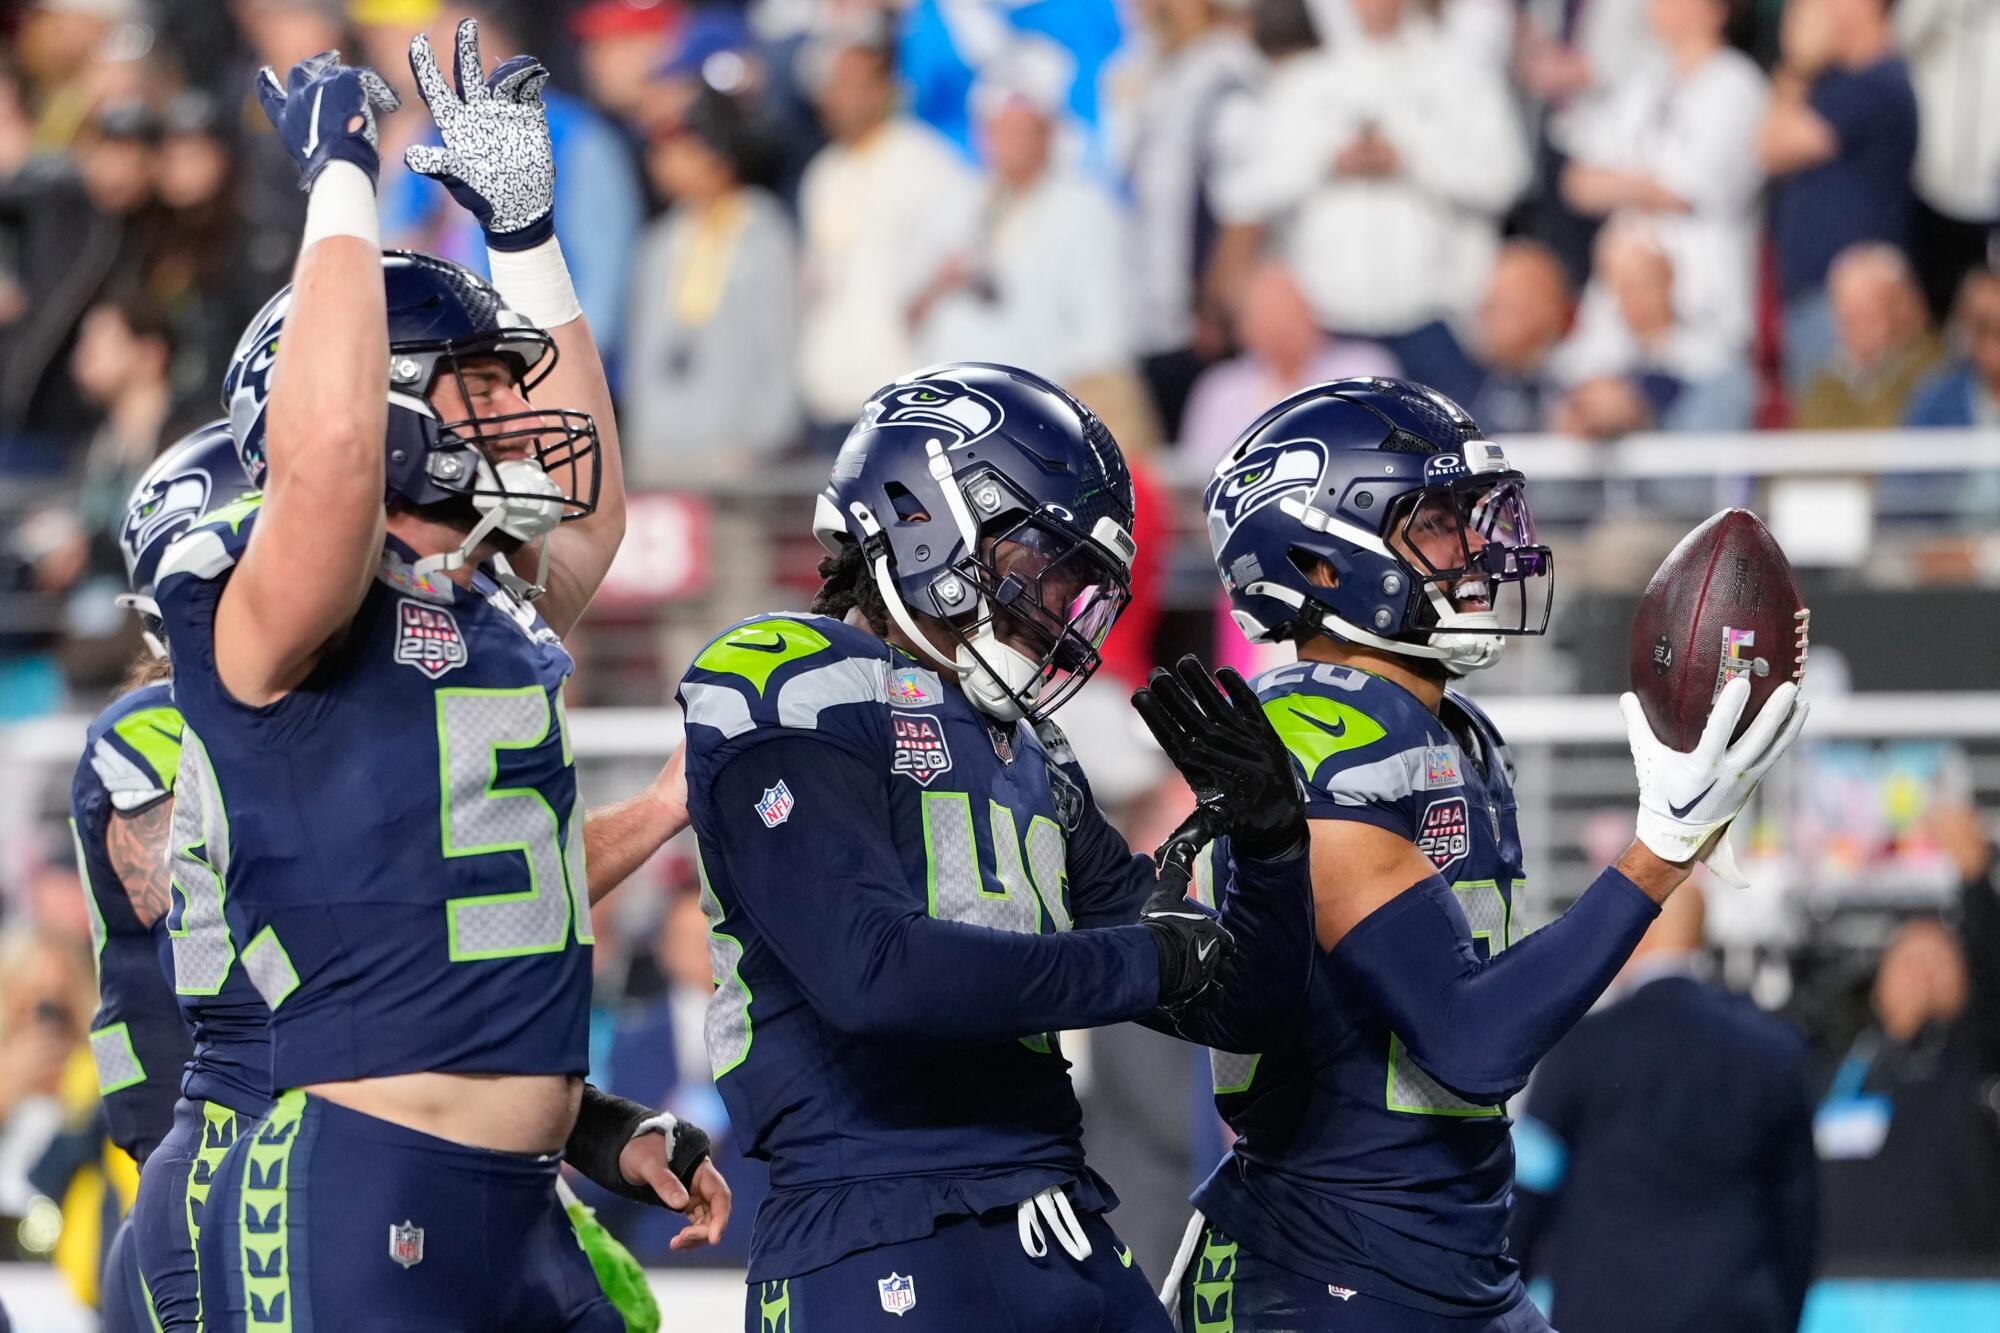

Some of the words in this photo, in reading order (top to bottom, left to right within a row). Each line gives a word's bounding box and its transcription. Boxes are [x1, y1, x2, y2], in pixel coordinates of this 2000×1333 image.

[1428, 466, 1467, 477] OAKLEY
[402, 607, 451, 630] USA
[400, 638, 461, 661] 250
[1720, 636, 1730, 668] SUPER
[892, 720, 937, 738] USA
[894, 749, 948, 770] 250
[765, 796, 791, 824] NFL
[1428, 804, 1464, 827] USA
[1418, 834, 1466, 856] 250
[886, 1291, 911, 1308] NFL
